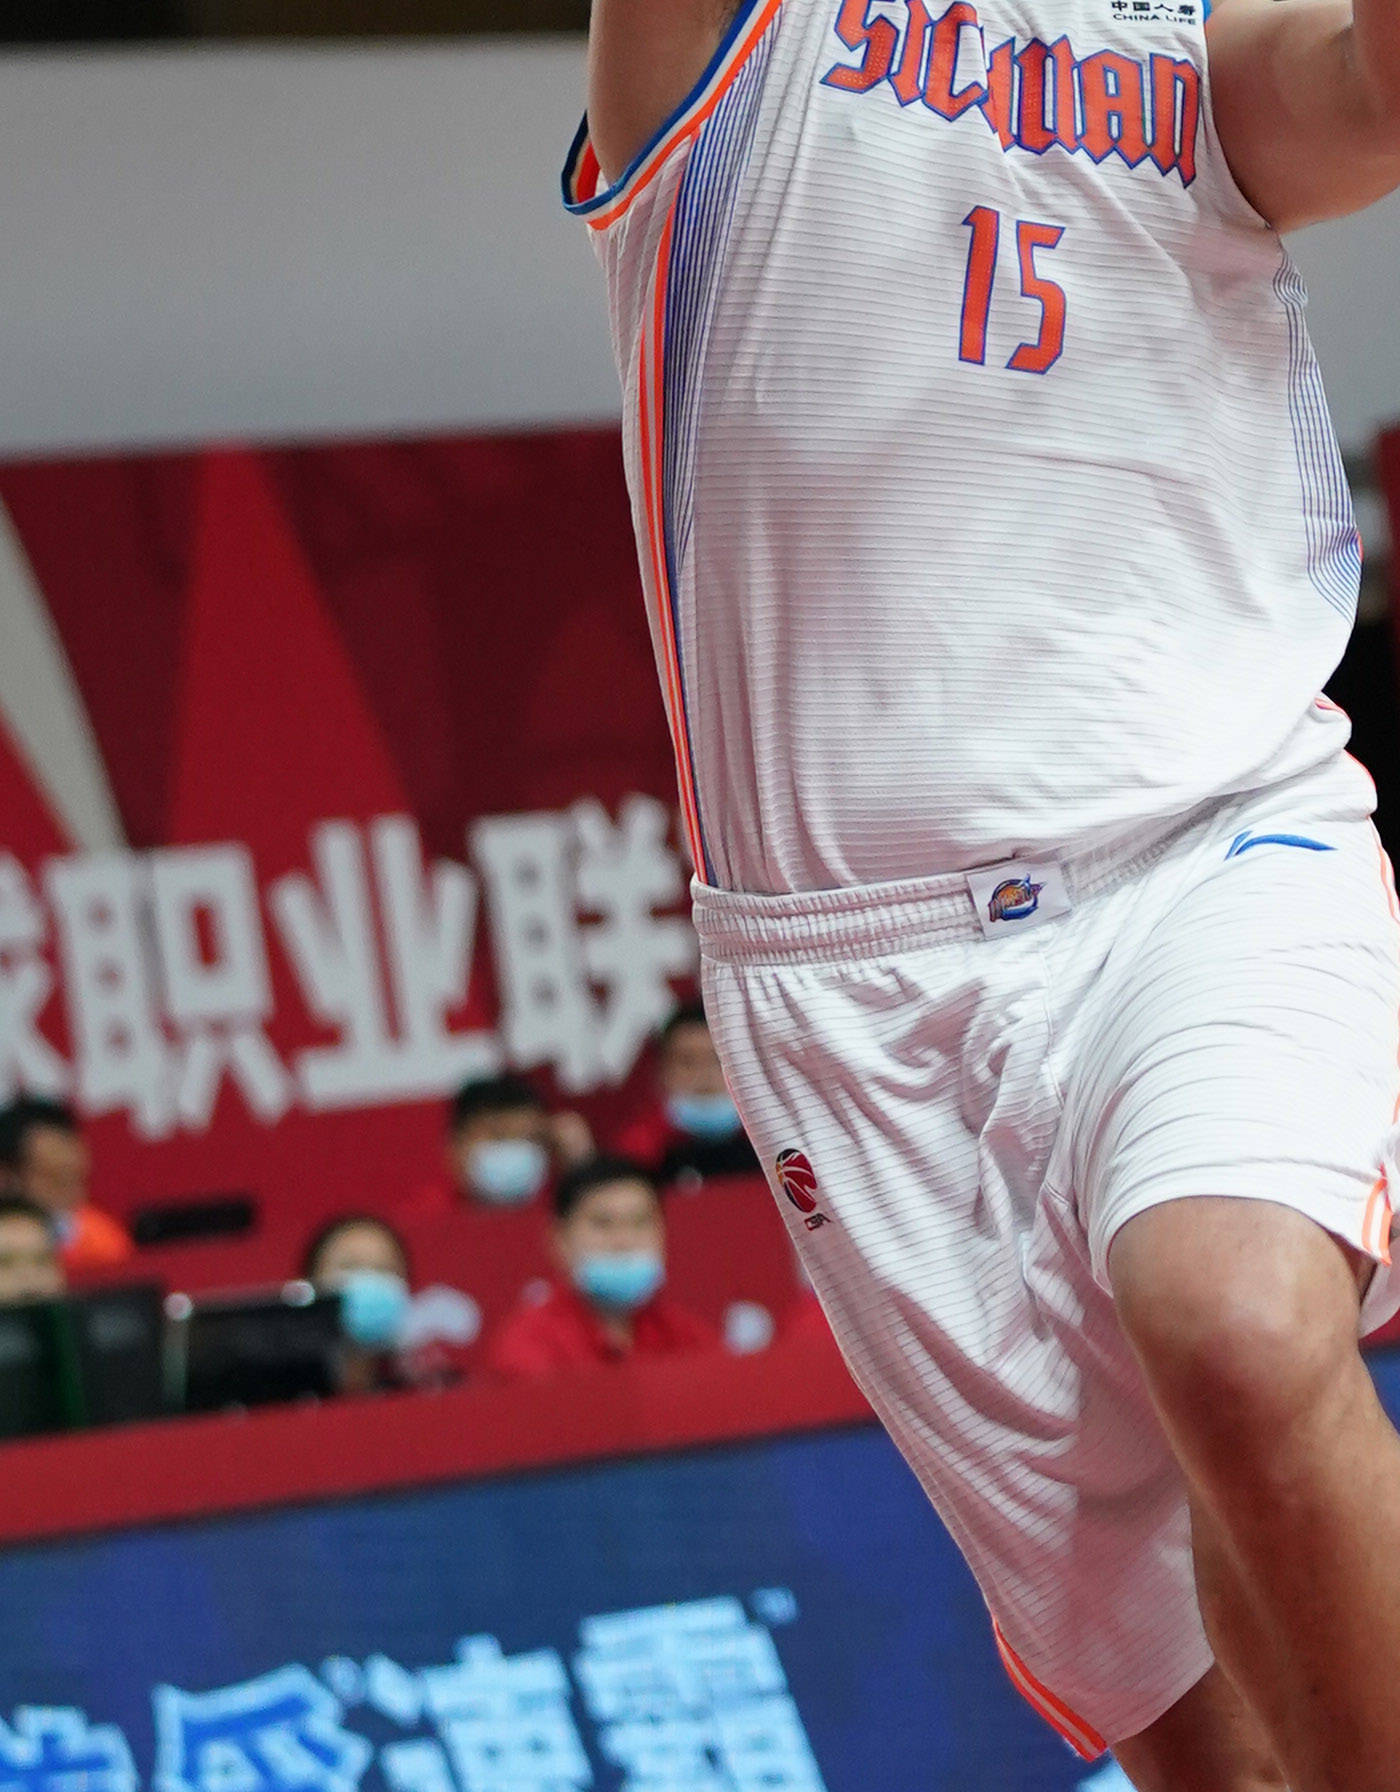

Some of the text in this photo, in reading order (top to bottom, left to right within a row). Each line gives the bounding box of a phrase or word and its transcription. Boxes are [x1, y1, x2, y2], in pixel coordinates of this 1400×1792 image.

[1112, 13, 1197, 26] CHINA LIFE
[958, 205, 1067, 375] 15
[0, 793, 697, 1143] 职业联
